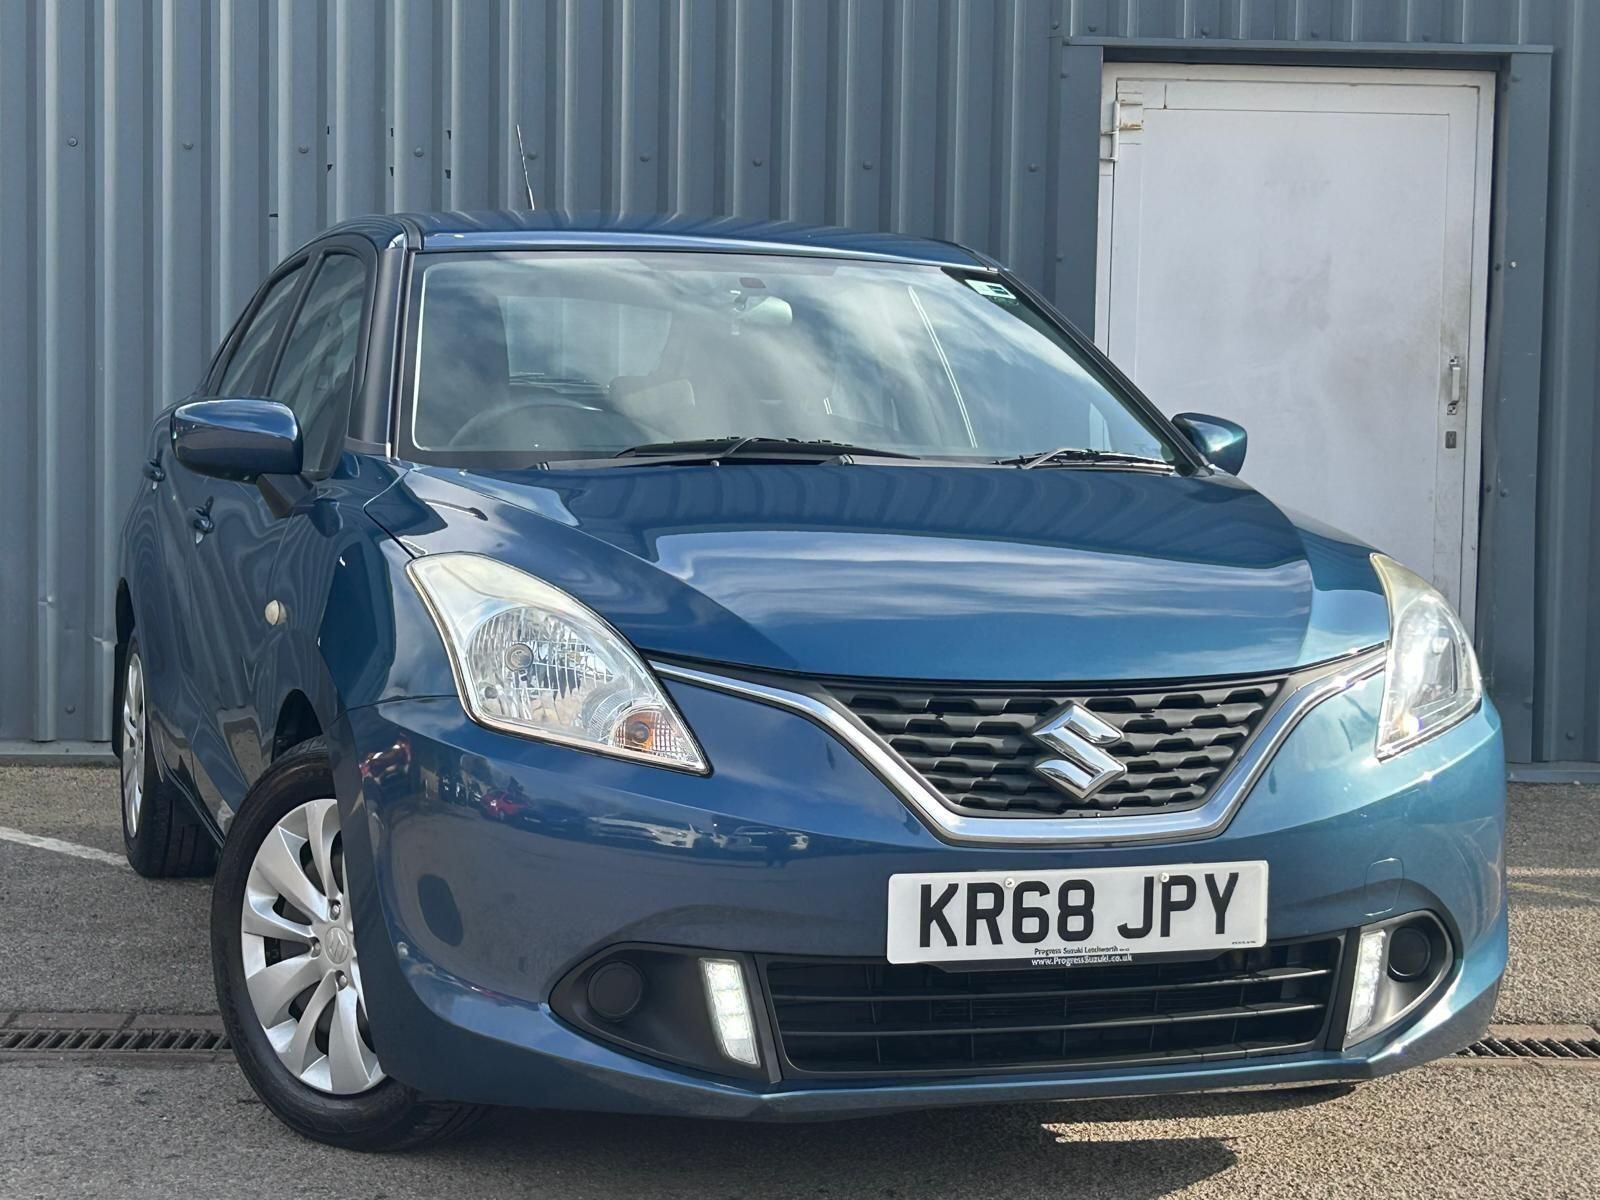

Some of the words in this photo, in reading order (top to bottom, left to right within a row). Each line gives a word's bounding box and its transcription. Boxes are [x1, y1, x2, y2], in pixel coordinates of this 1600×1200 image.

[919, 879, 1095, 948] KR68
[1117, 872, 1240, 940] JPY
[1034, 947, 1062, 957] Progress
[1031, 953, 1133, 967] www.ProgressSuzuki.co.uk
